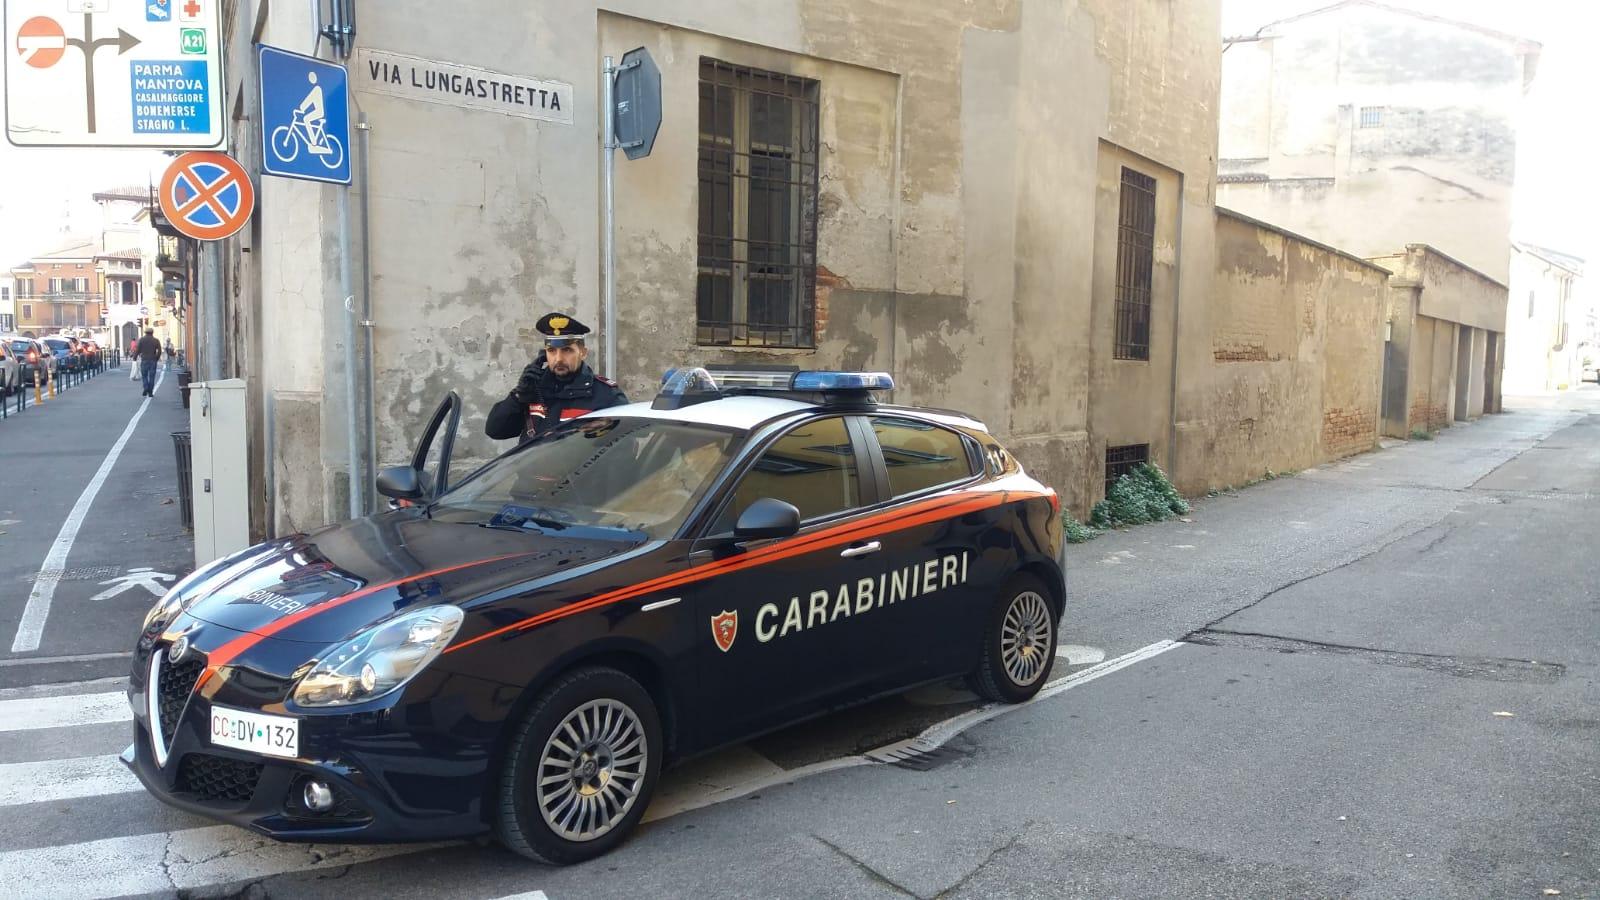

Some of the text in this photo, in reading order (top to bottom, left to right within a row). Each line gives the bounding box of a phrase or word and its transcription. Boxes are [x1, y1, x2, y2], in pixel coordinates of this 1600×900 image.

[135, 64, 183, 76] PARMA
[135, 78, 204, 90] MANTOVA
[369, 59, 561, 111] VIA LUNGASTRETTA
[135, 93, 204, 103] CASALMAGGIORE
[136, 106, 196, 116] BONEMERSE
[137, 120, 190, 130] STAGNO L.
[754, 551, 968, 643] CARABINIERI
